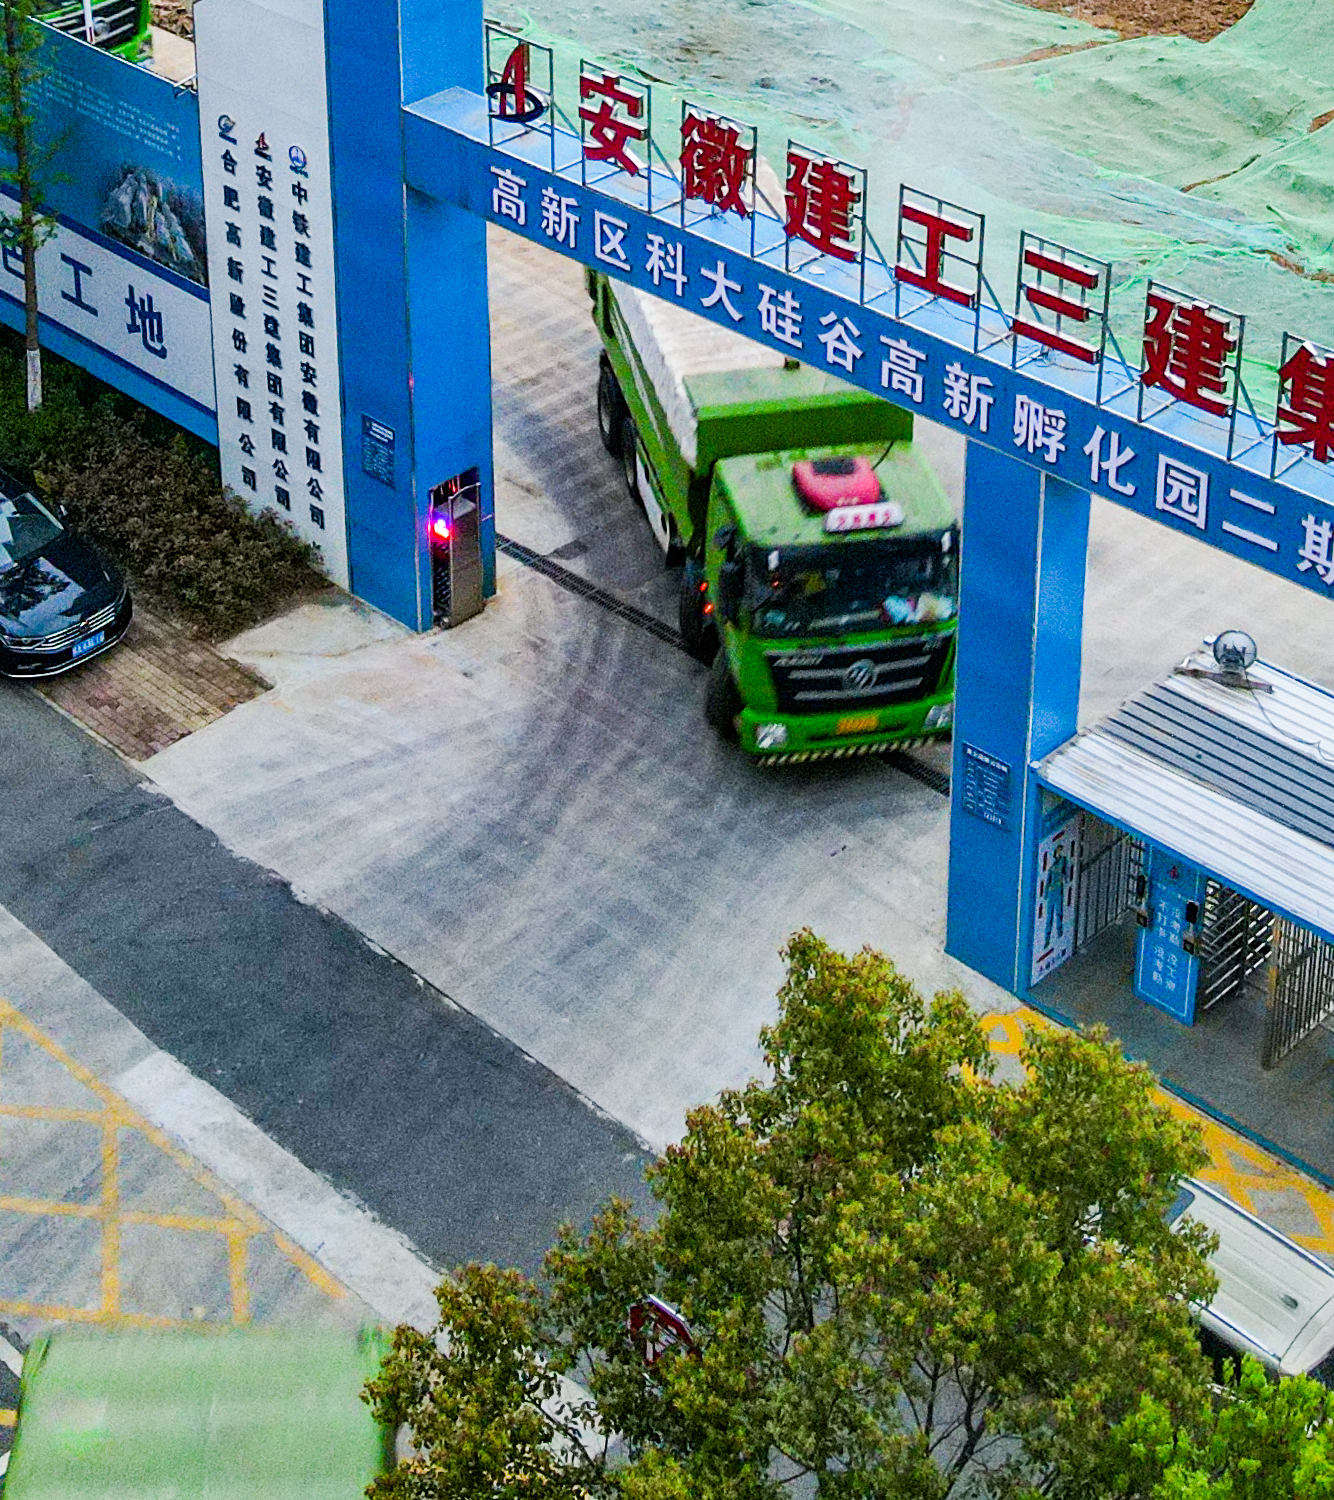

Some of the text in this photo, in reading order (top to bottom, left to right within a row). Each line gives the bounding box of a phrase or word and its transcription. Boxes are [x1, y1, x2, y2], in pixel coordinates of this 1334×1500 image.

[255, 165, 291, 511] 安徽建工三建集团有限公司
[291, 181, 325, 530] 中铁建工集团安徽有限公司
